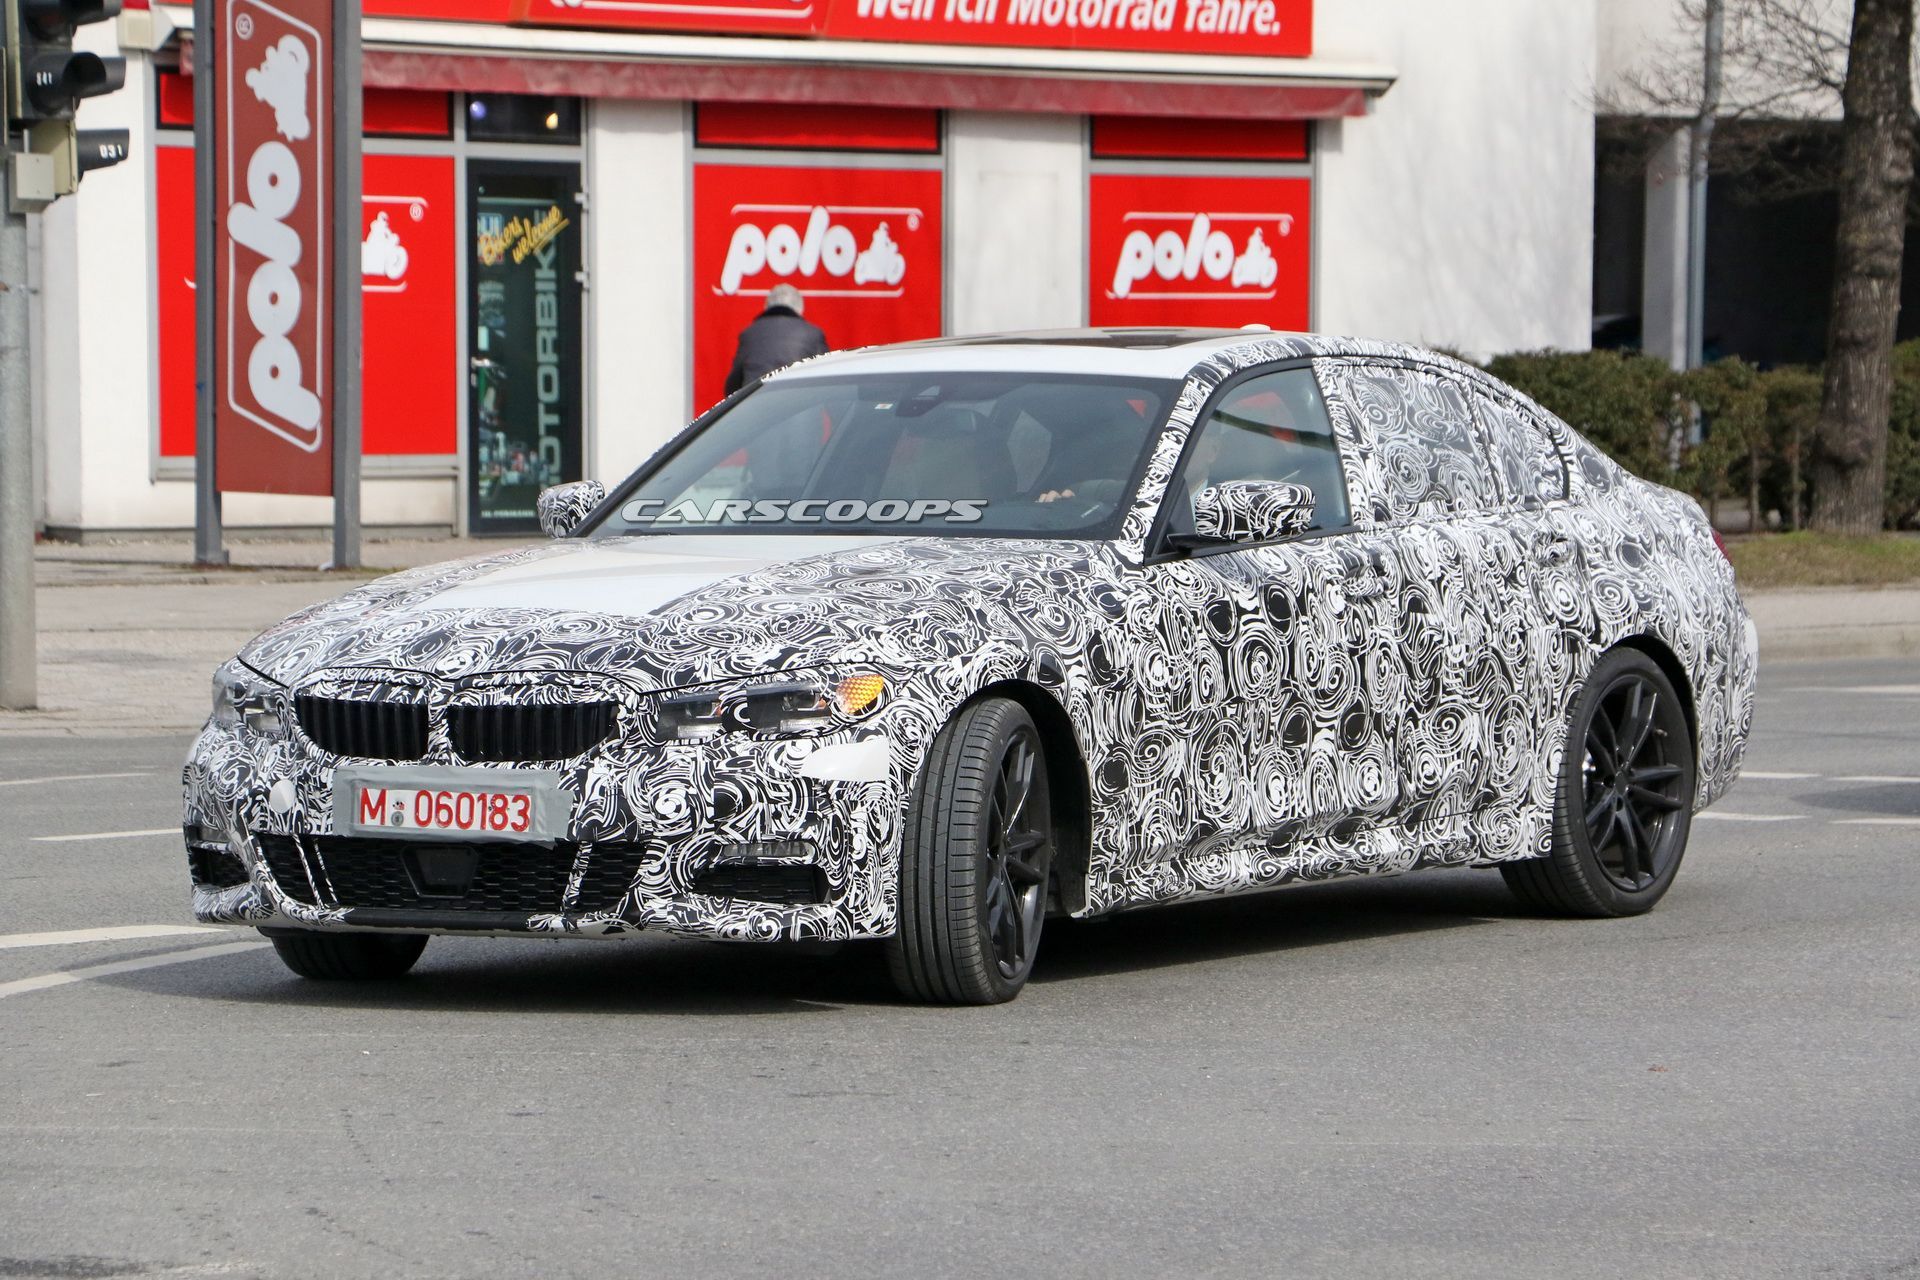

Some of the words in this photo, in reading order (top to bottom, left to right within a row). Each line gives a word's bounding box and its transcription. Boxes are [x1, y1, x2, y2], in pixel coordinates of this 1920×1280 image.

[1006, 0, 1173, 31] Motorrad
[1183, 0, 1281, 36] fahre.
[227, 140, 322, 431] polo
[720, 205, 857, 295] polo
[1112, 213, 1235, 298] polo
[535, 209, 561, 490] OTORBIK
[359, 787, 387, 826] M
[413, 789, 532, 832] 060183
